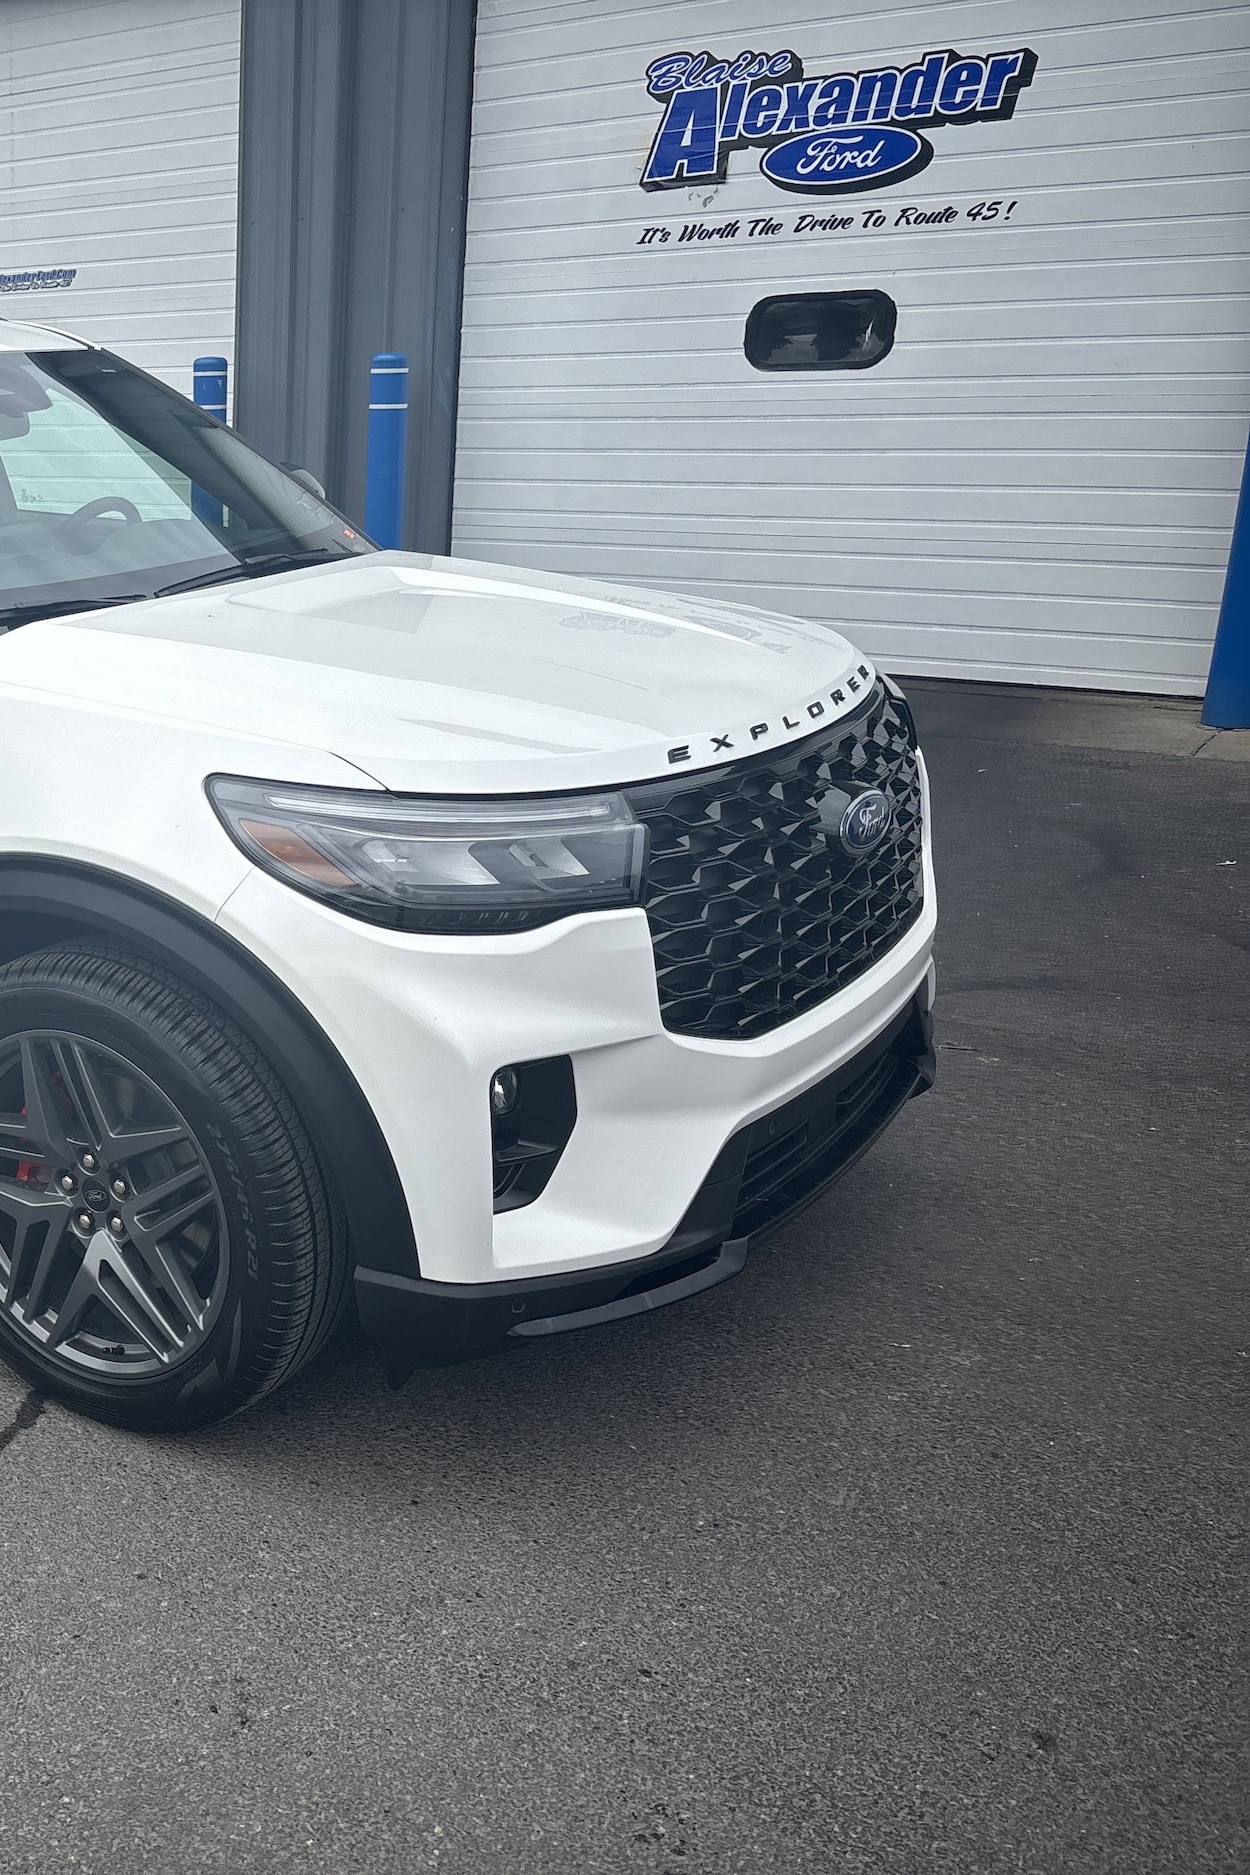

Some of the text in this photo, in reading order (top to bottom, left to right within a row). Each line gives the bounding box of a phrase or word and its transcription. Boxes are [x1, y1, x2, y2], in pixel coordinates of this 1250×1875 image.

[649, 49, 793, 93] Blaise
[643, 50, 1030, 184] Alexander
[796, 136, 883, 175] Ford
[635, 200, 1019, 245] It's Worth The Drive To Route 45!
[667, 664, 869, 764] EXPLORER
[858, 803, 886, 838] Ford
